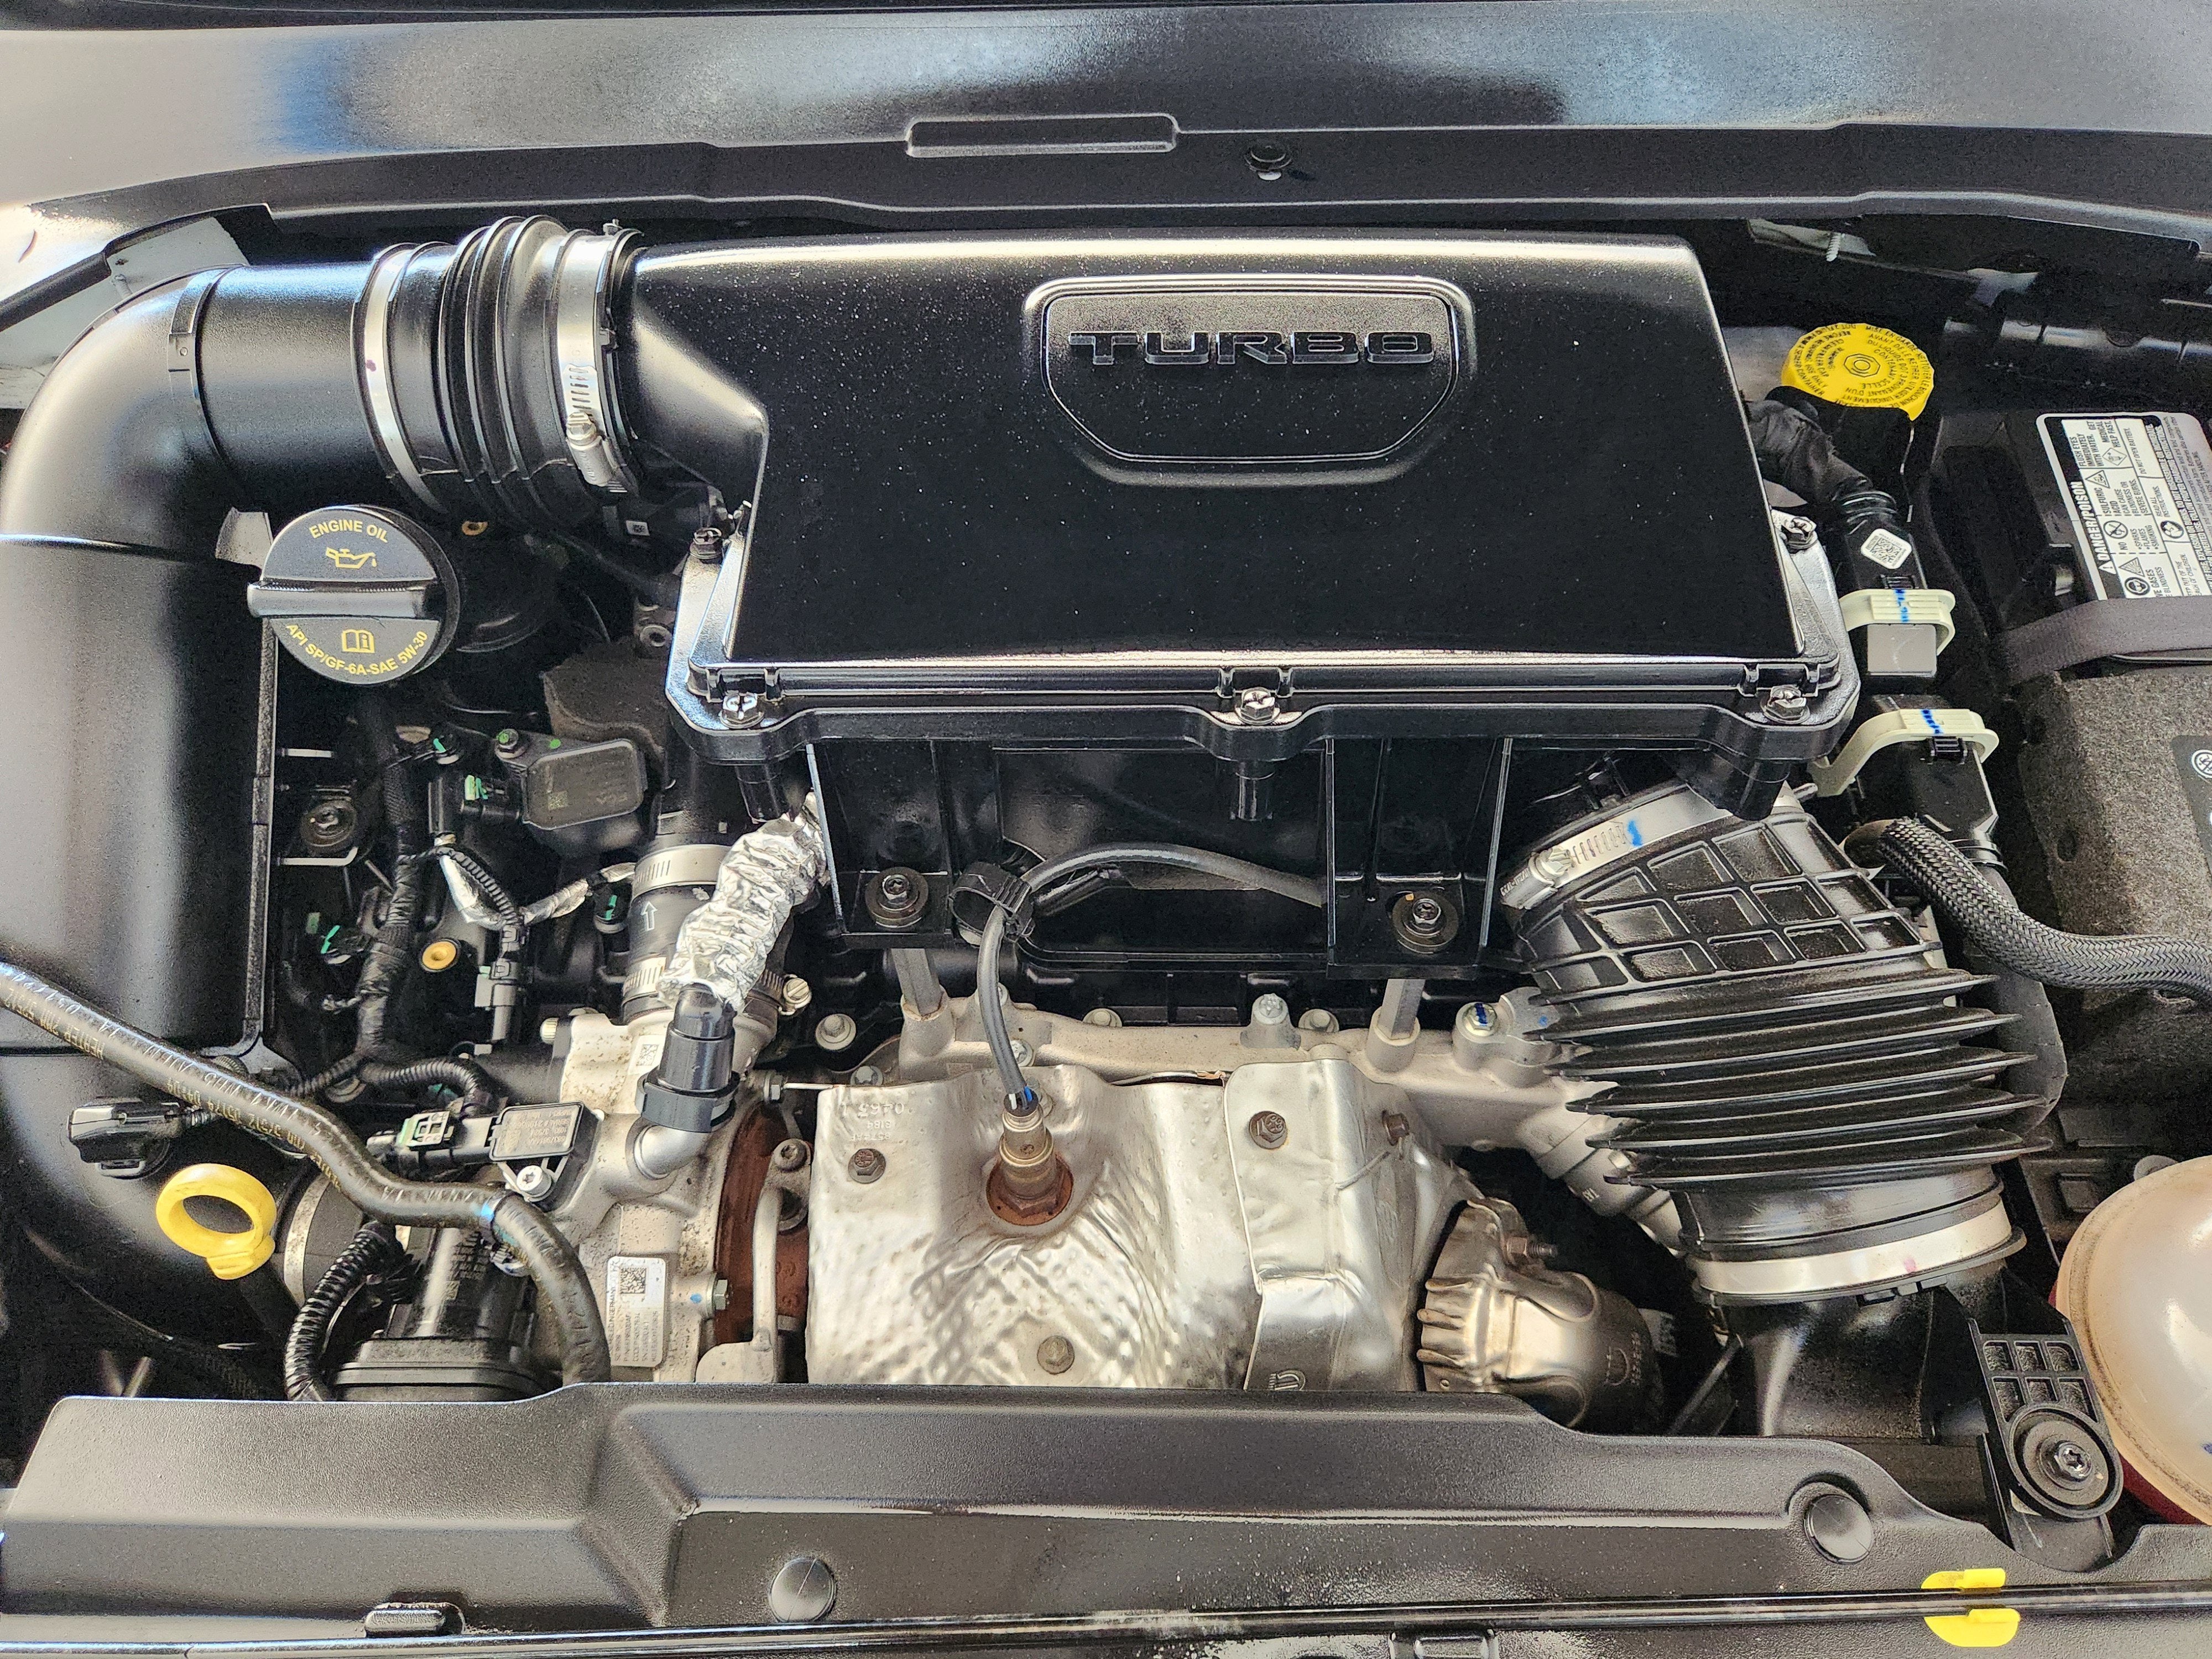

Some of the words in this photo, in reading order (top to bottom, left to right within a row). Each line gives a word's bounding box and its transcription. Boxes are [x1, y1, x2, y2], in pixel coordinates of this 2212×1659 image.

[1869, 333, 1894, 344] AVANT
[1896, 335, 1917, 351] GARDE
[1068, 330, 1434, 365] TURBO
[1879, 345, 1905, 362] LIQUIDE
[1817, 367, 1829, 377] CAP
[1899, 363, 1909, 374] DOT
[1796, 368, 1825, 396] CONTAINER
[1812, 375, 1827, 387] ONLY
[1867, 379, 1906, 397] PROVENANT
[1842, 395, 1894, 404] UNIQUEMENT
[1845, 387, 1865, 397] D'UN
[1901, 387, 1927, 406] BOUCHON
[2086, 421, 2096, 430] GET
[2096, 421, 2110, 442] MEDICAL
[2104, 420, 2115, 434] FAST.
[2069, 436, 2080, 449] EYES
[2087, 434, 2100, 452] WATER.
[2110, 435, 2121, 447] HELP
[2124, 427, 2136, 446] BATTERY.
[2077, 434, 2095, 467] IMMEDIATELY
[2131, 448, 2140, 458] OPEN
[2075, 451, 2086, 467] FLUSH
[2094, 453, 2104, 467] WITH
[2136, 459, 2144, 467] NOT
[2094, 488, 2111, 513] SULFURIC
[2115, 489, 2125, 503] CAUSE
[2171, 491, 2181, 500] NOT
[2178, 483, 2192, 502] PROPER
[2110, 501, 2121, 513] ACID
[2121, 504, 2130, 514] CAN
[2124, 489, 2139, 513] BLINDNESS
[2136, 496, 2148, 513] SEVERE
[2152, 506, 2162, 517] READ
[2185, 502, 2199, 521] FOLLOW
[2069, 481, 2110, 561] DANGER/POISON
[309, 519, 363, 539] ENGINE
[367, 525, 388, 544] OIL
[2189, 533, 2206, 560] EXPLOSION
[2146, 569, 2160, 587] GASES
[2155, 567, 2171, 593] BLINDNESS
[2192, 585, 2202, 596] EACH
[286, 624, 306, 646] API
[398, 630, 429, 664] 5W-30
